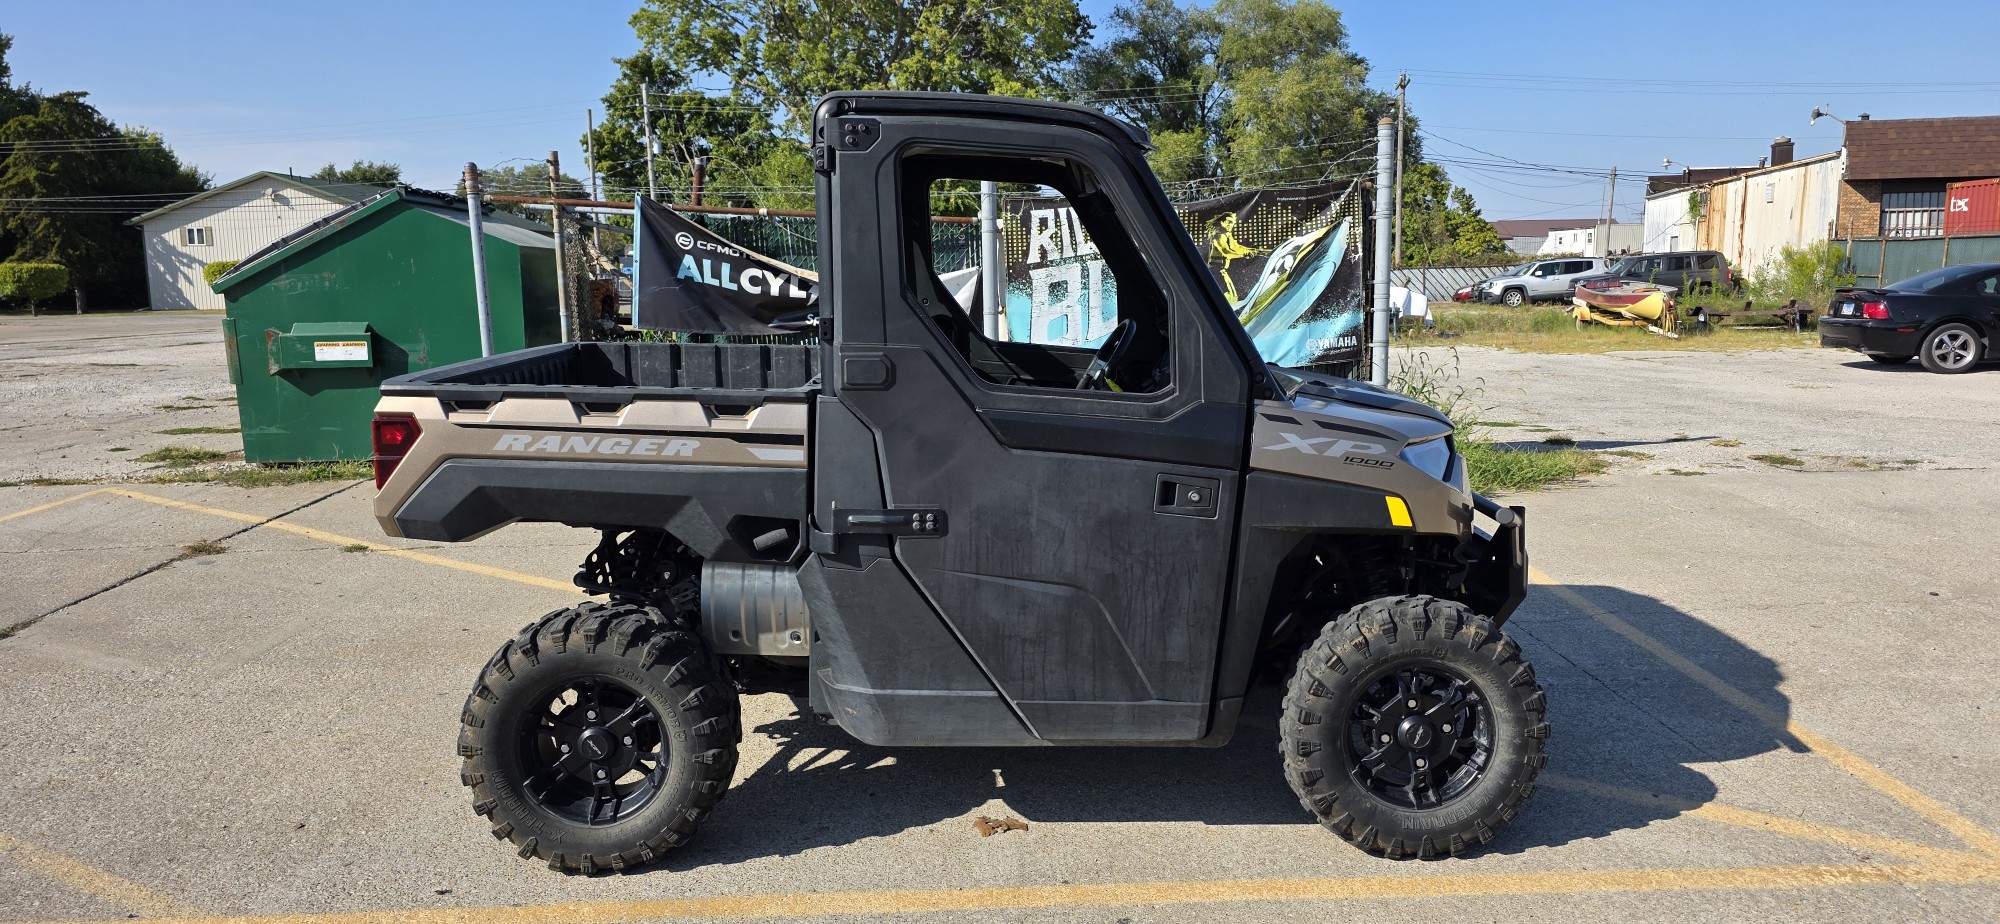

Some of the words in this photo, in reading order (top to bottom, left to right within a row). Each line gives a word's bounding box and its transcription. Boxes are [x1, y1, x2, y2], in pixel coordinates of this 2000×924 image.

[1318, 335, 1358, 350] YAMAHA
[492, 434, 701, 457] RANGER
[1260, 432, 1387, 458] XP
[1343, 456, 1395, 468] 1000
[615, 667, 644, 686] PRO
[644, 684, 682, 729] ARMOR
[492, 769, 568, 844] X-TERRAIN
[1402, 787, 1496, 830] X-TERRAIN
